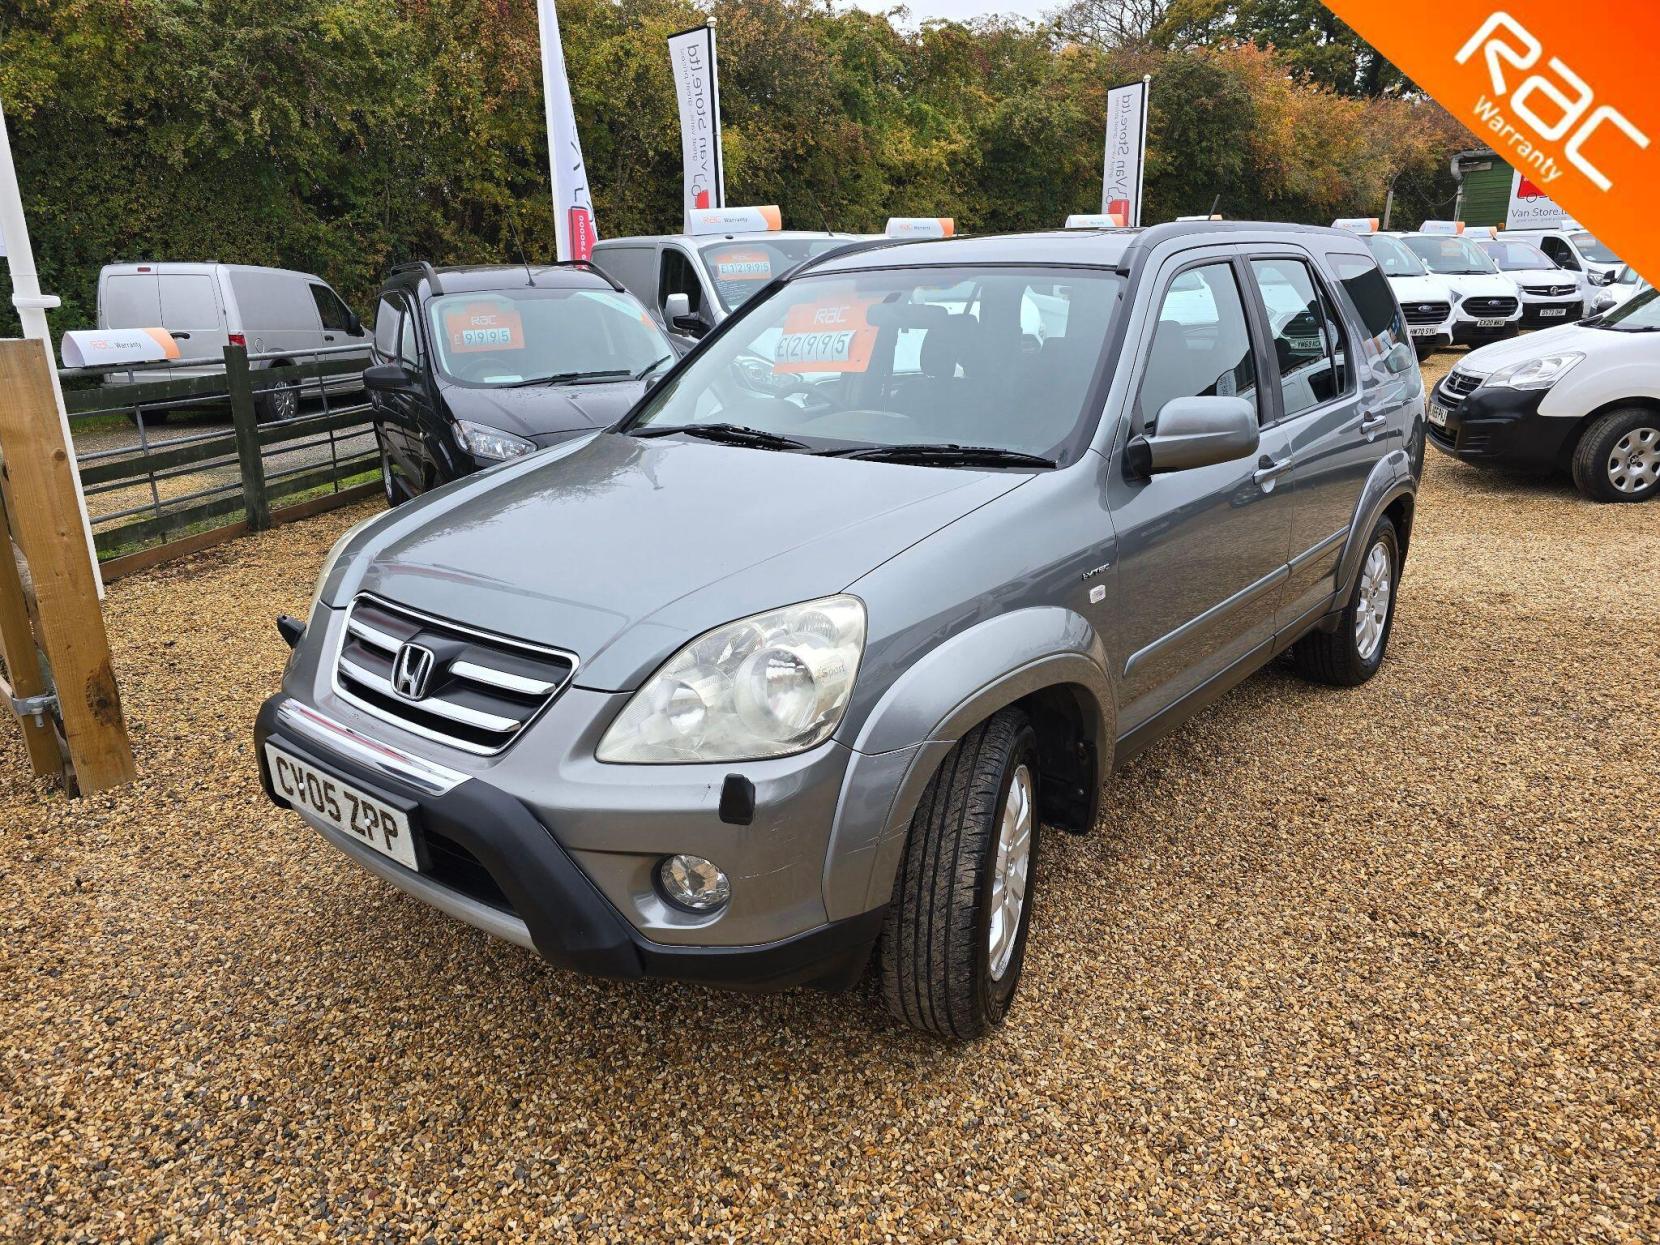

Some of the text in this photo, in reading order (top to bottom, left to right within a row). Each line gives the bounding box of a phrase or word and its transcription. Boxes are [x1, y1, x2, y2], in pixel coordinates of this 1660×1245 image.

[1511, 209, 1530, 218] Van
[276, 756, 399, 851] CV05 ZPP
